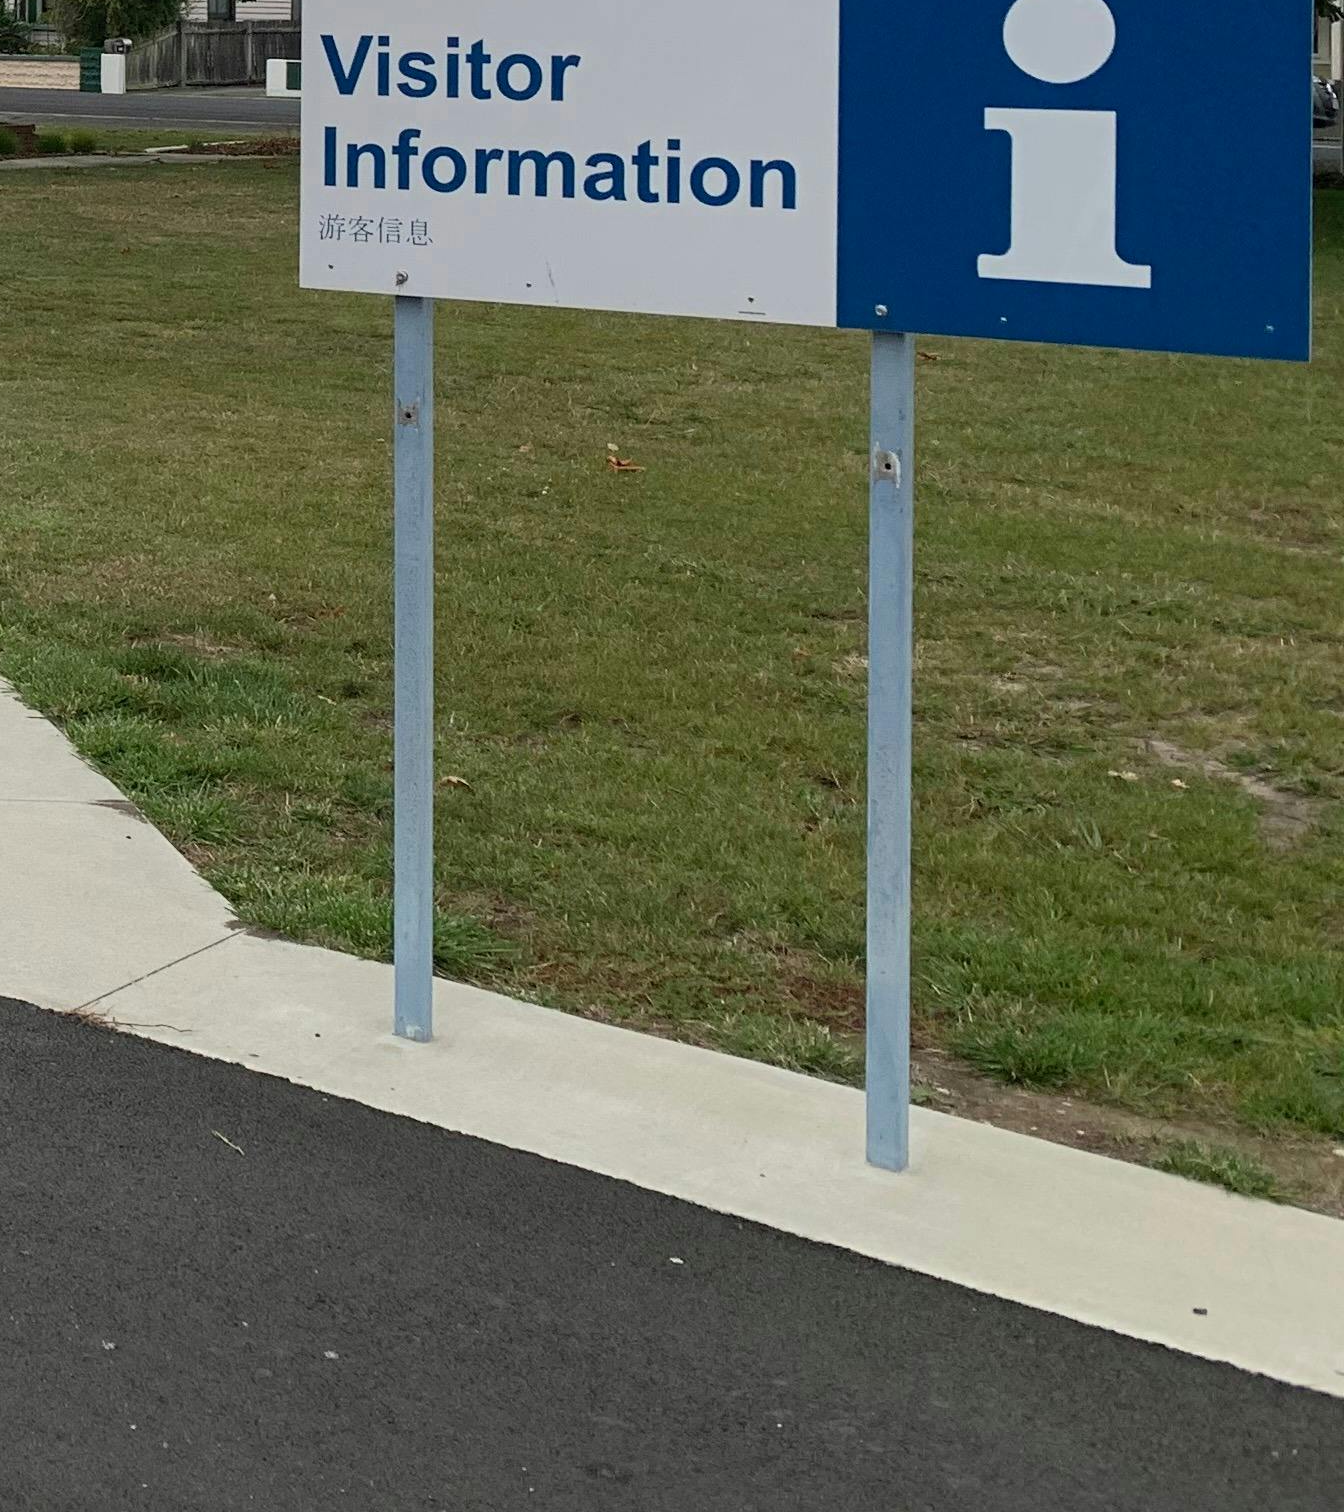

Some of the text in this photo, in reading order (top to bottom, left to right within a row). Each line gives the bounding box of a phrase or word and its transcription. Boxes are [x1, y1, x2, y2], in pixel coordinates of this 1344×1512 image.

[319, 33, 582, 102] Visitor
[323, 125, 797, 210] Information
[318, 213, 433, 246] 游客信息
